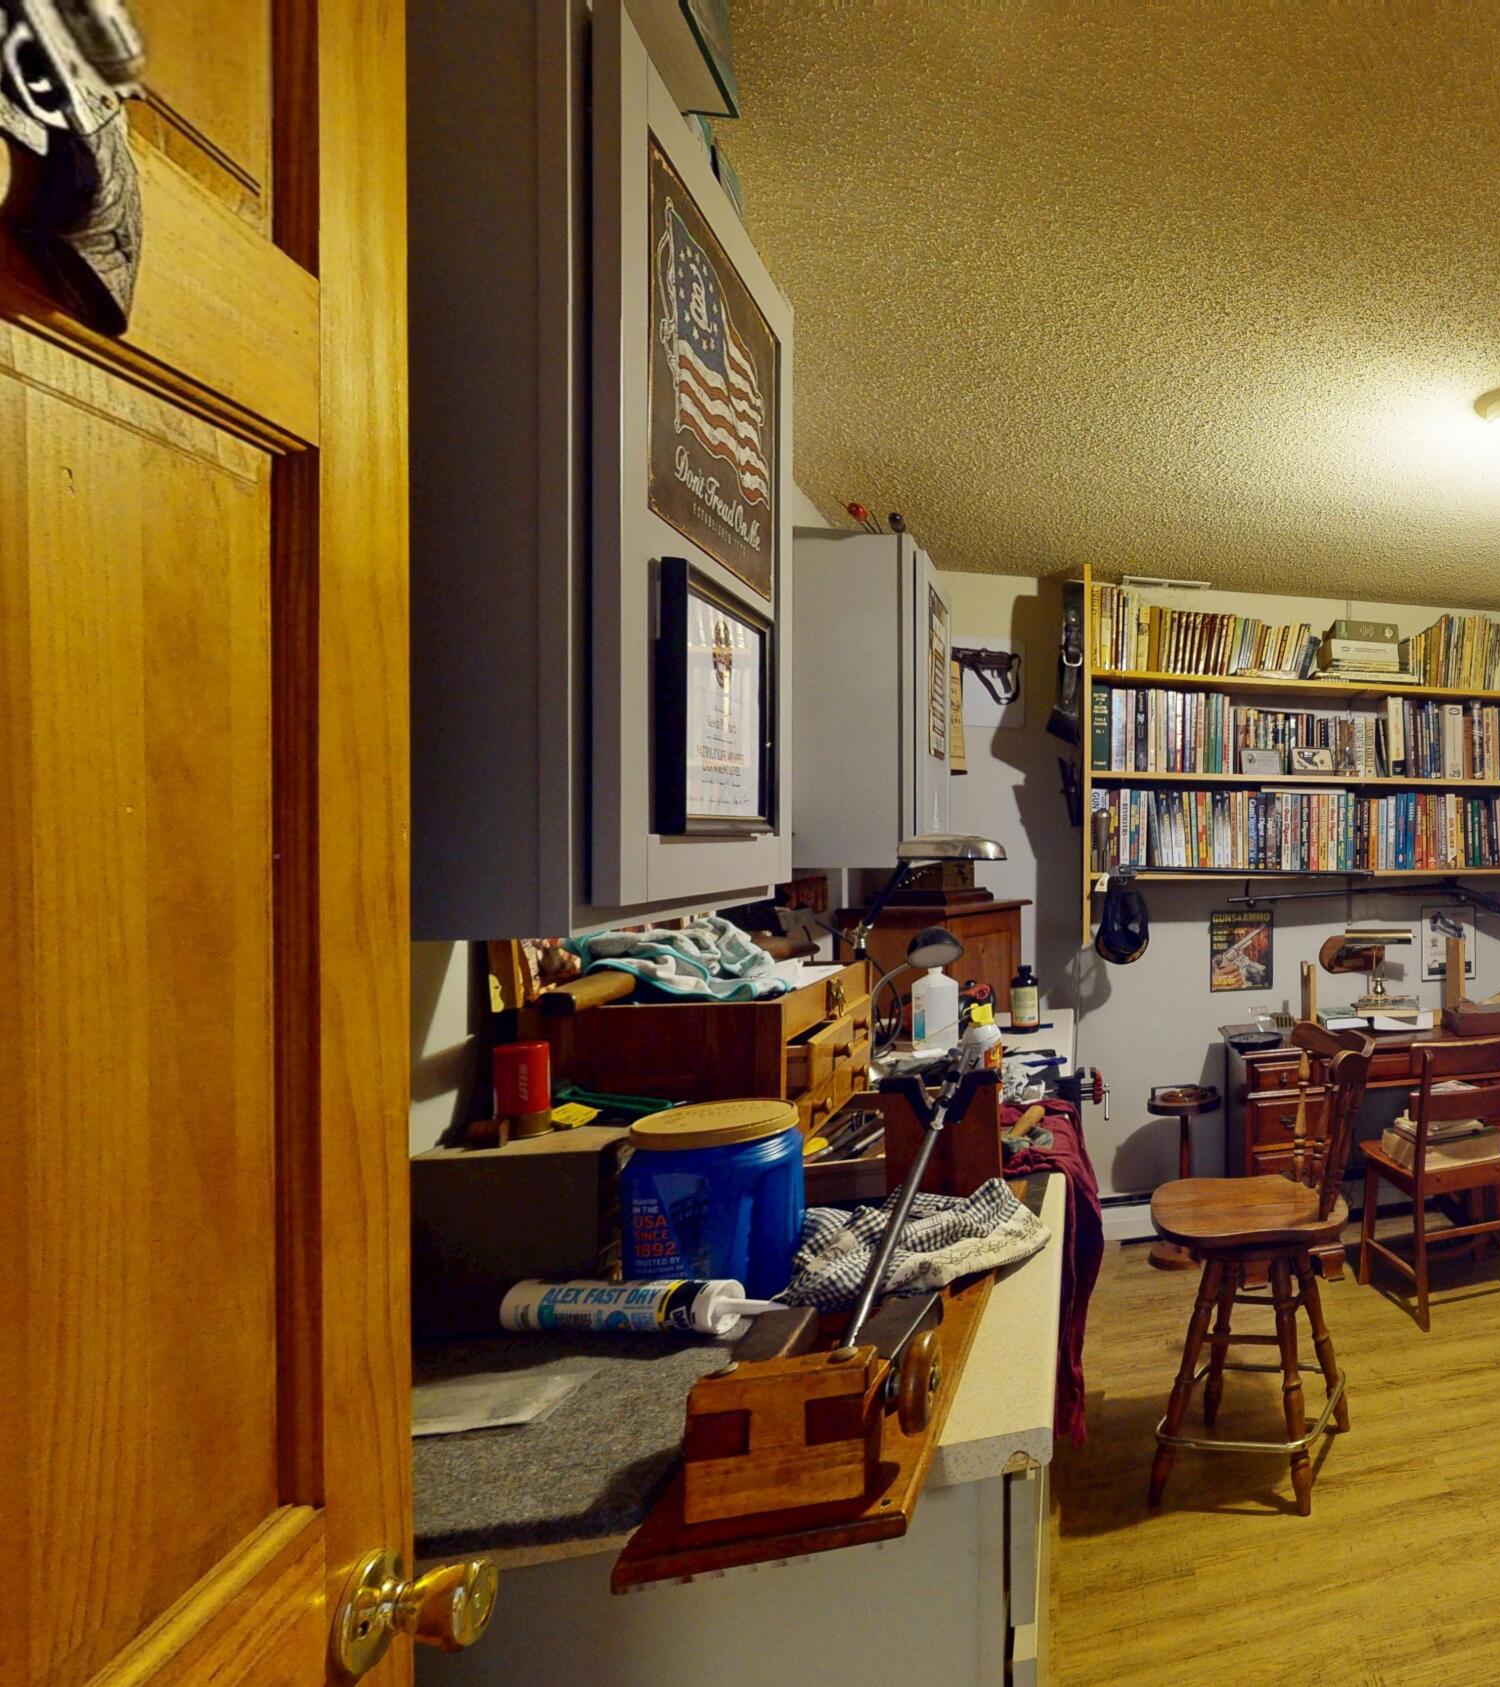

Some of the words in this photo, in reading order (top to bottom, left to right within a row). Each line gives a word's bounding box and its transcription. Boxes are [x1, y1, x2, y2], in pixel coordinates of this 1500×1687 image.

[705, 476, 737, 527] Tread
[735, 505, 750, 541] On
[748, 520, 760, 552] Me
[633, 1213, 668, 1230] USA
[634, 1228, 670, 1241] SINCE
[635, 1241, 676, 1258] 1892
[542, 1286, 585, 1305] ALEX
[583, 1287, 626, 1305] FAST
[622, 1287, 662, 1305] DRY
